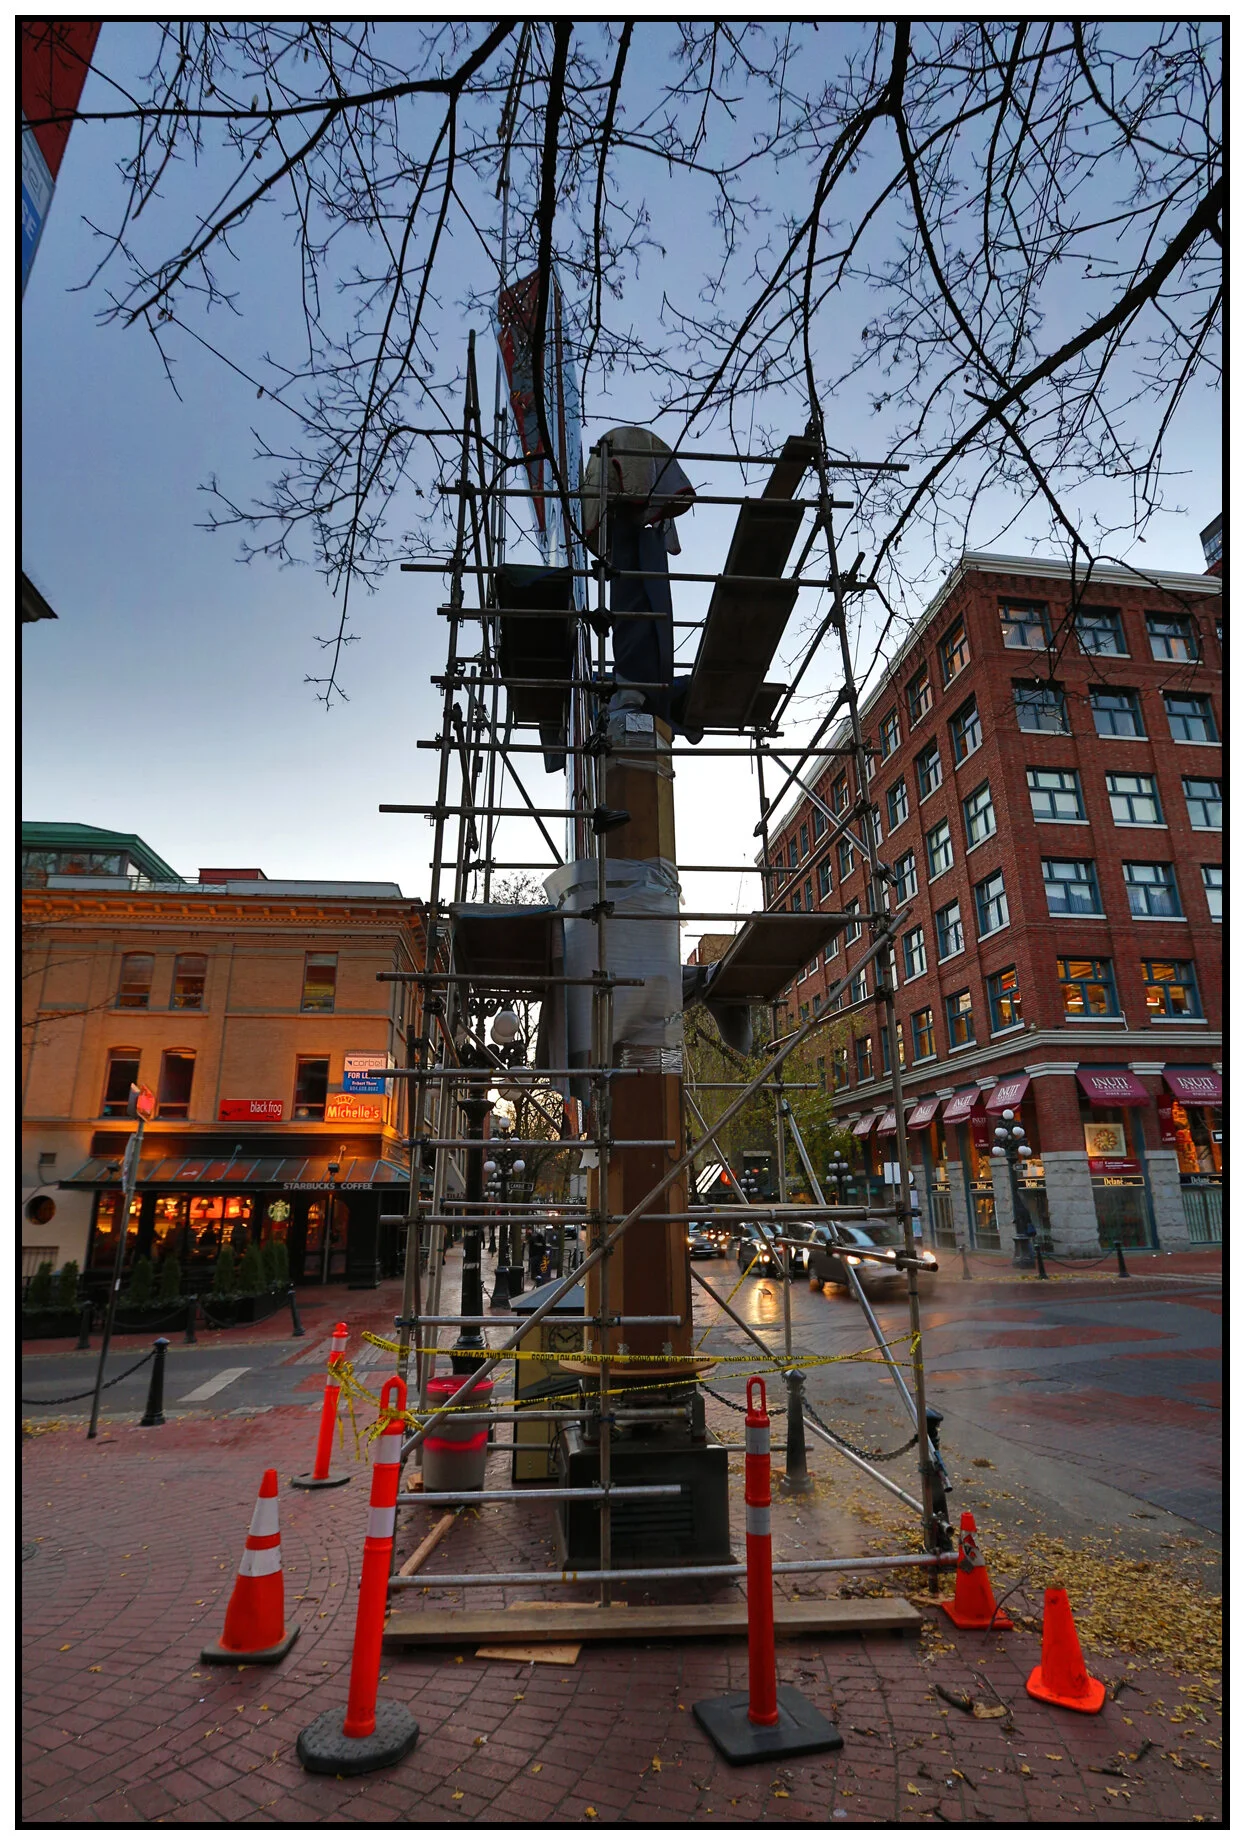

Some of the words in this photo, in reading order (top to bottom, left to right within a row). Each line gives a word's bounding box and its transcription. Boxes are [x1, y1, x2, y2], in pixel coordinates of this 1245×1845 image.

[1091, 1077, 1129, 1087] INUIT
[1177, 1077, 1214, 1087] INUIT
[997, 1084, 1020, 1096] INUIT
[250, 1101, 267, 1113] black
[268, 1101, 282, 1116] frog
[327, 1105, 380, 1119] Michelle's
[283, 1182, 336, 1190] STARBUCKS
[341, 1182, 373, 1190] COFFEE
